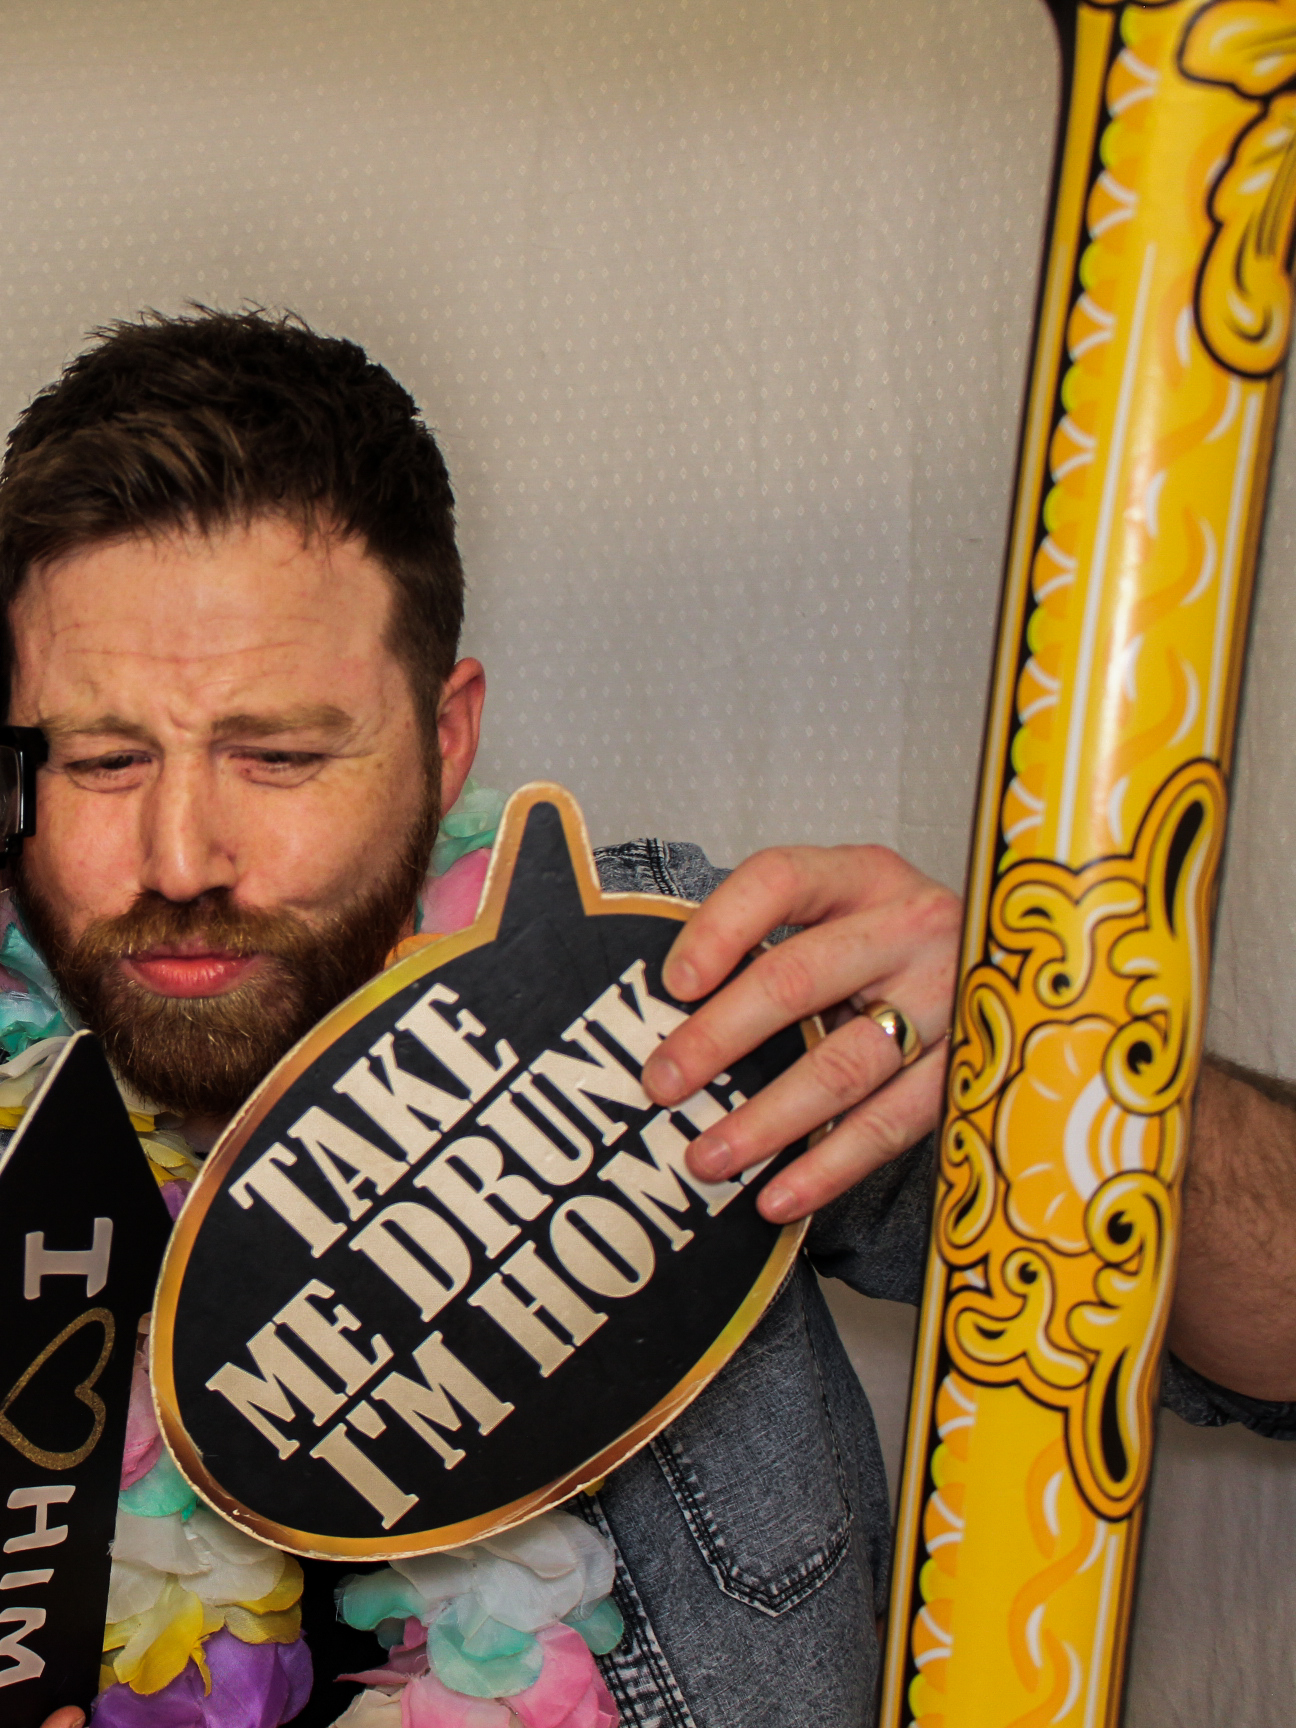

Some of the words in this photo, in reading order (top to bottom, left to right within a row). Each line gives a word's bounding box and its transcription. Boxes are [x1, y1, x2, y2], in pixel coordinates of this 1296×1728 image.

[206, 1278, 394, 1460] ME
[348, 958, 690, 1322] DRUNK
[228, 982, 519, 1259] TAKE
[23, 1217, 113, 1300] I
[310, 1331, 515, 1530] I'M
